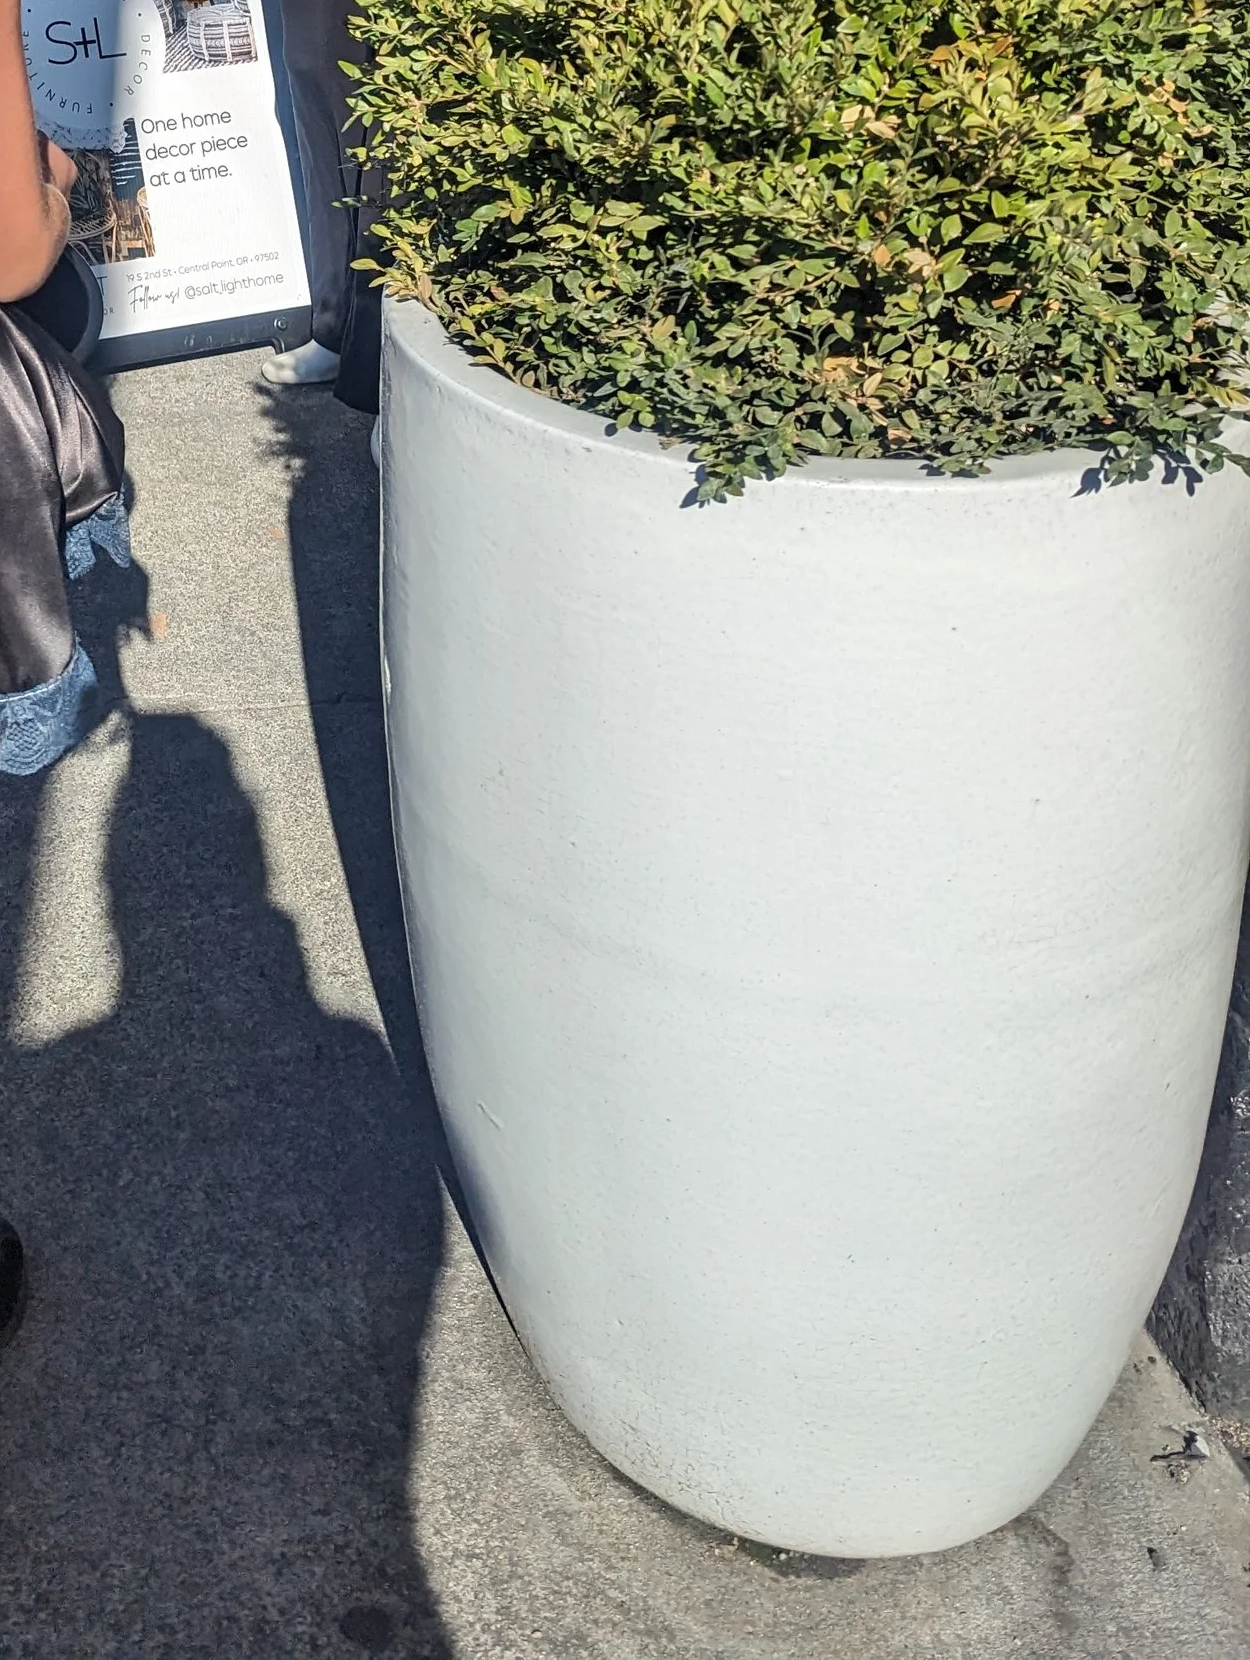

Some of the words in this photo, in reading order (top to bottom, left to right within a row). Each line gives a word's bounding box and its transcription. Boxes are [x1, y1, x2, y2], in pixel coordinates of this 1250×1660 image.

[124, 34, 151, 96] DECOR
[141, 118, 178, 134] One
[180, 111, 232, 129] home
[145, 143, 196, 161] decor
[200, 135, 248, 157] piece
[150, 171, 170, 187] at
[173, 170, 186, 184] a
[189, 164, 232, 182] time.
[136, 272, 143, 282] S
[144, 269, 161, 281] 2nd
[162, 268, 172, 278] St
[178, 261, 210, 275] Central
[236, 255, 249, 266] OR
[254, 251, 279, 262] 97502
[127, 284, 162, 313] Follow
